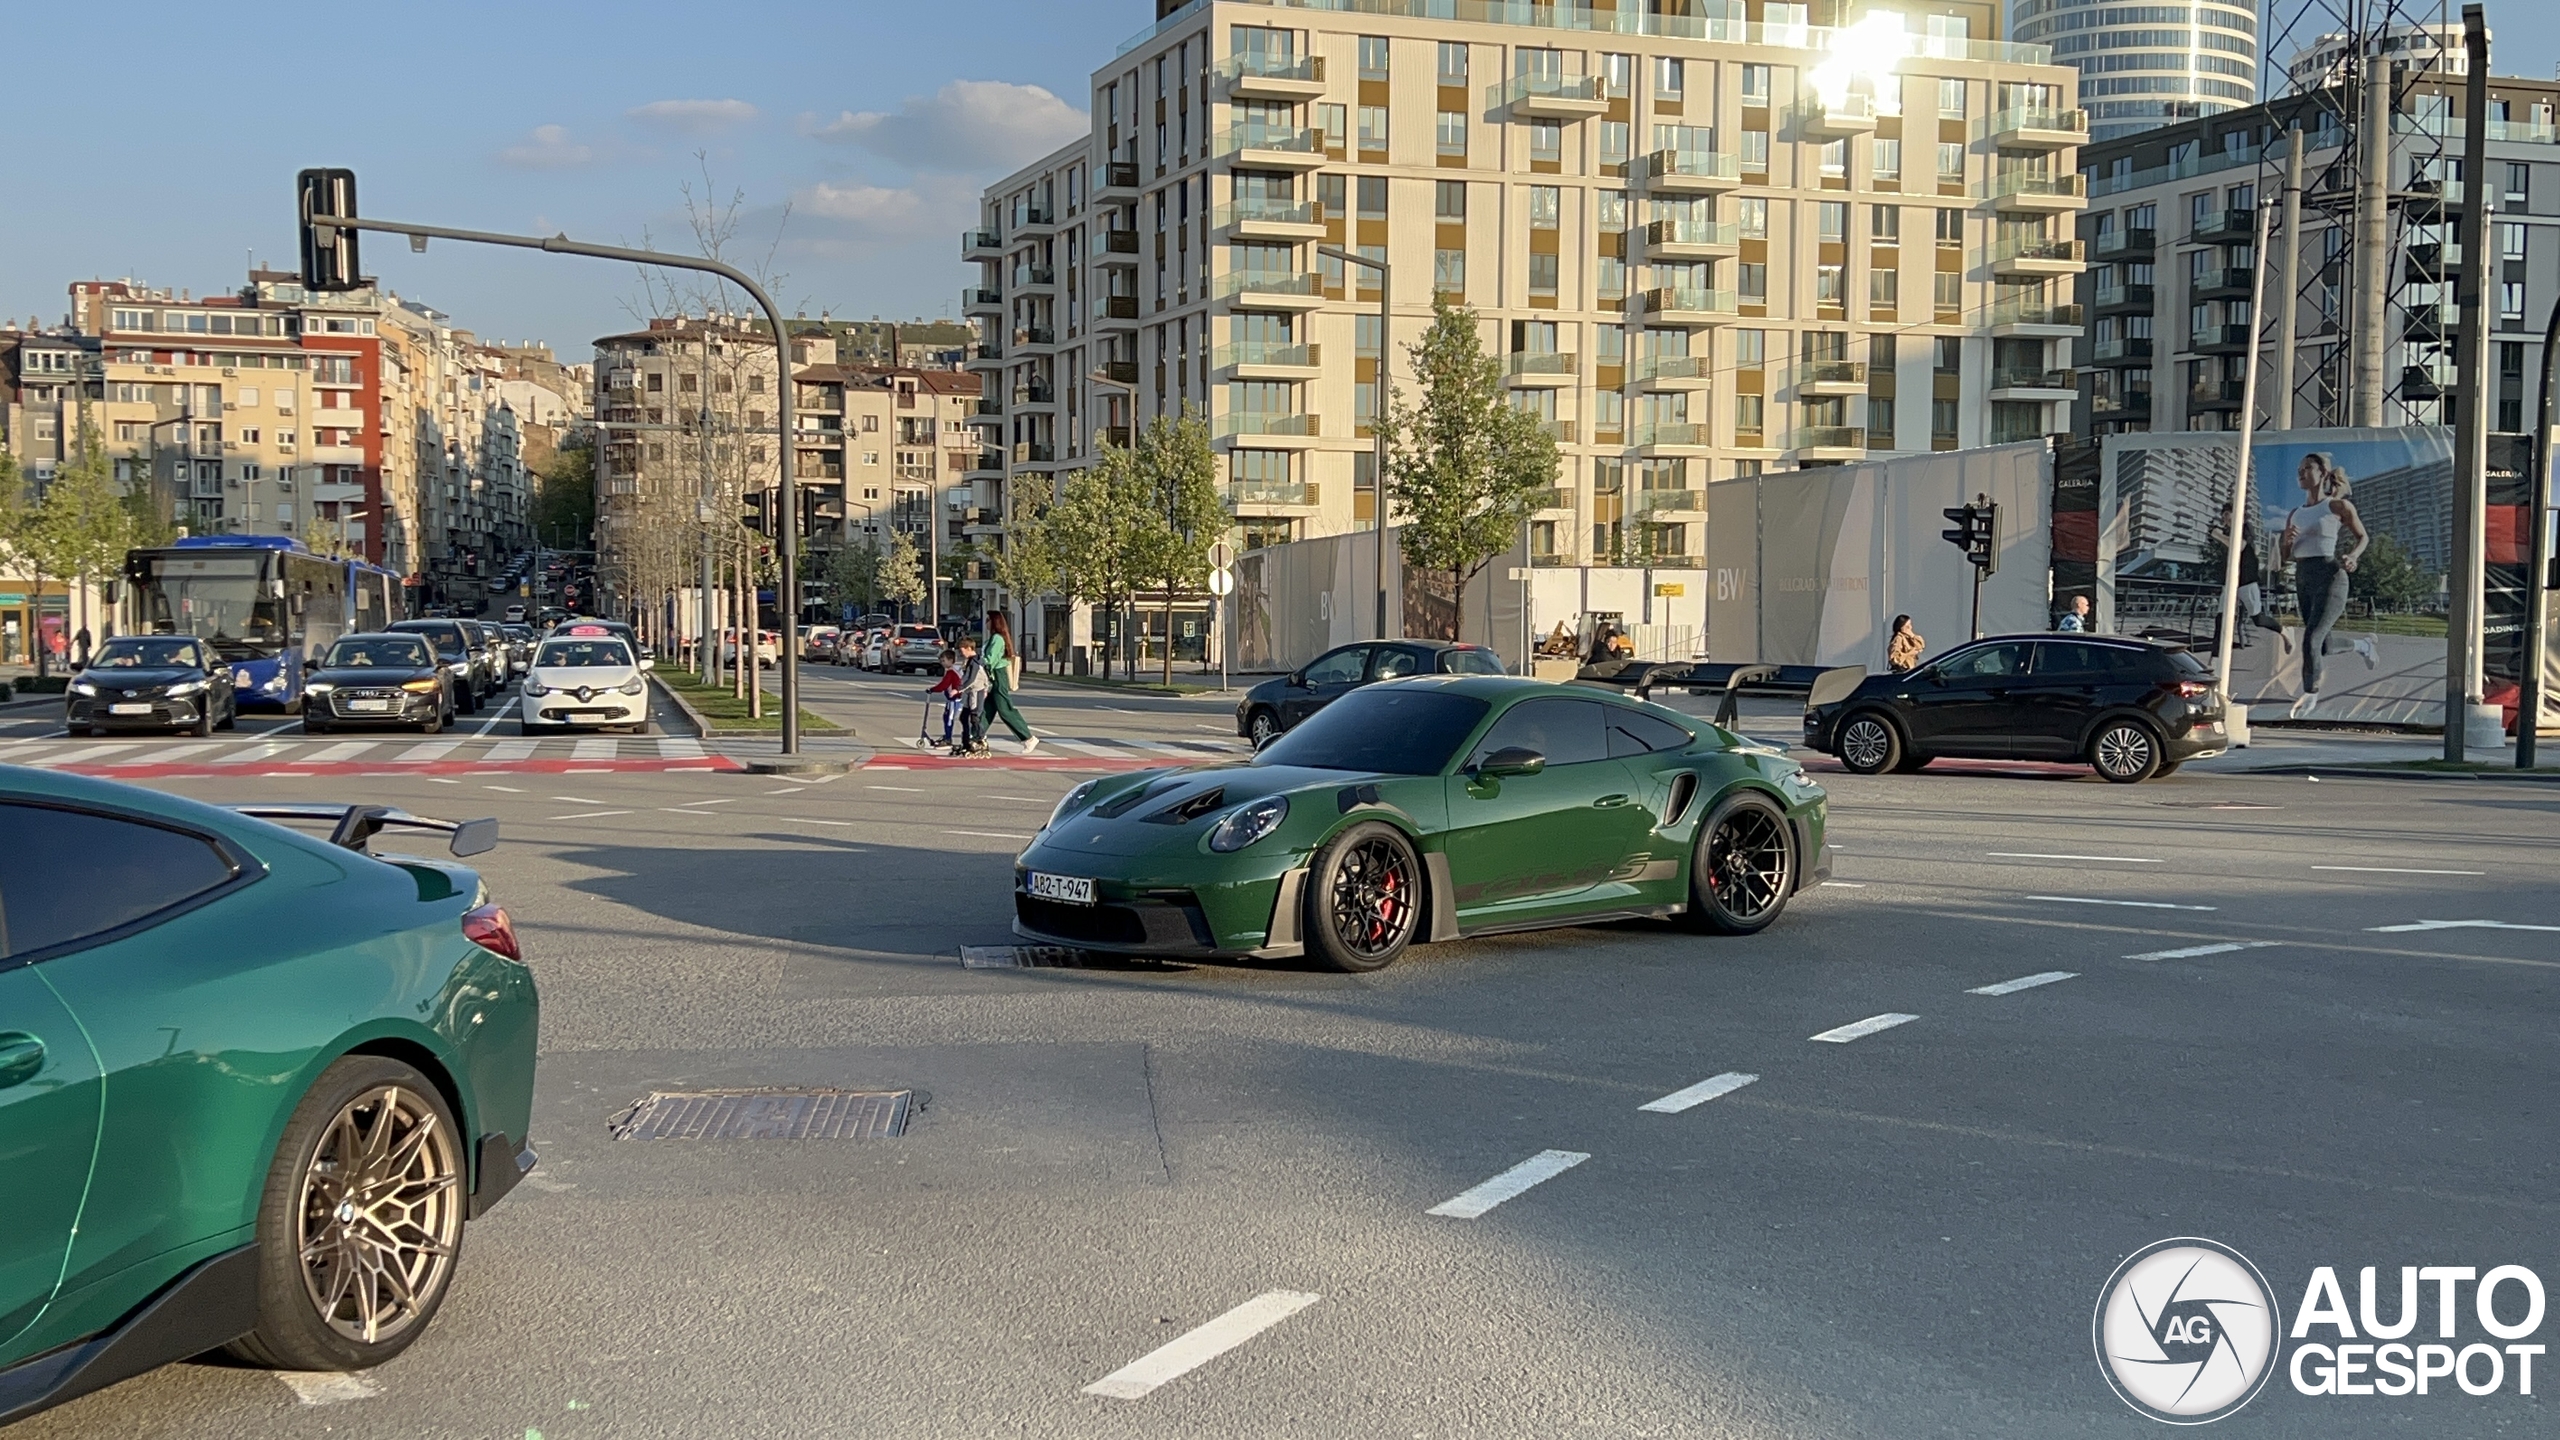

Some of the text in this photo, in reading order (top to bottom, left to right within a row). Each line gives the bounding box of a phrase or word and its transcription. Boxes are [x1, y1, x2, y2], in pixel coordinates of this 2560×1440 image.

[2485, 470, 2524, 479] GALERIJA
[2058, 479, 2094, 488] GALERIJA
[1717, 568, 1747, 601] BW
[1779, 577, 1820, 592] BELGRADE
[2483, 624, 2520, 634] OADING
[1034, 874, 1089, 899] A82-T-947
